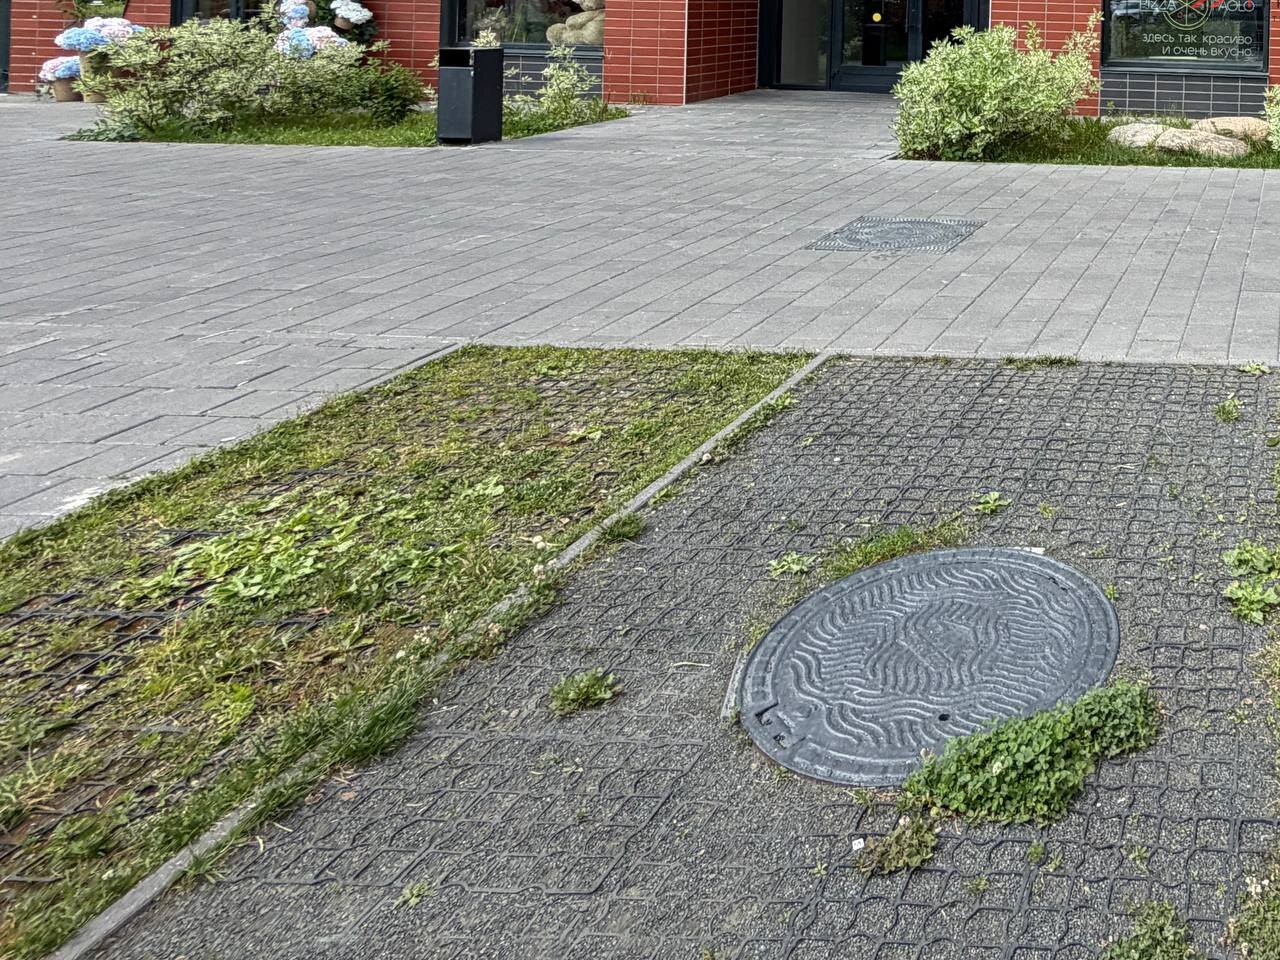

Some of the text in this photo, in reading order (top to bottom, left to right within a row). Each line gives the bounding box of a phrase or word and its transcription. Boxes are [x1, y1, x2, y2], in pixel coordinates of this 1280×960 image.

[1142, 33, 1253, 46] здесь так красиво
[1173, 46, 1208, 56] очень
